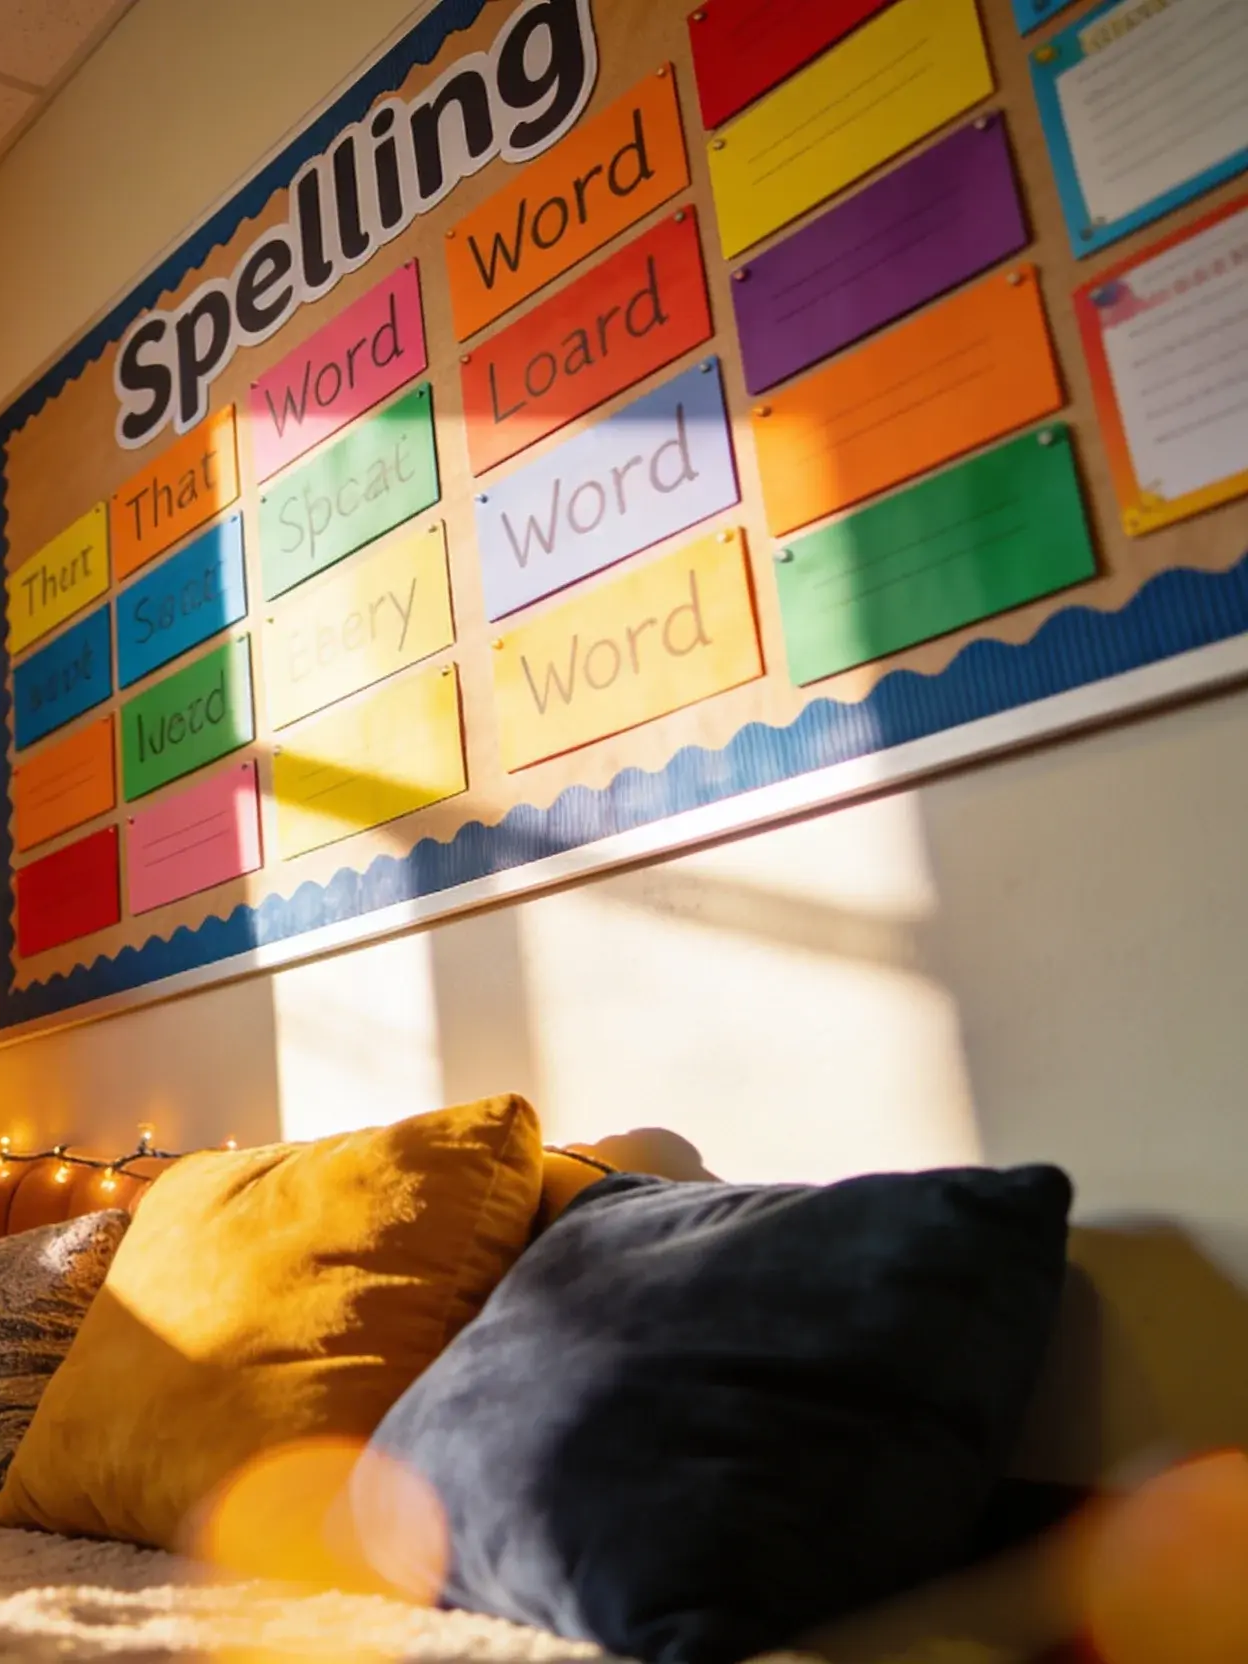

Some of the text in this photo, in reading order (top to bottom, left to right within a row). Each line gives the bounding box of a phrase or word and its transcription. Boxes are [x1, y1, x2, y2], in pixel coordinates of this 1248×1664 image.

[120, 0, 584, 441] Spelling
[467, 108, 655, 290] Word
[264, 292, 405, 438] Word
[489, 256, 669, 424] Loard
[126, 449, 218, 540] That
[501, 402, 700, 569] Word
[521, 570, 712, 715] Word
